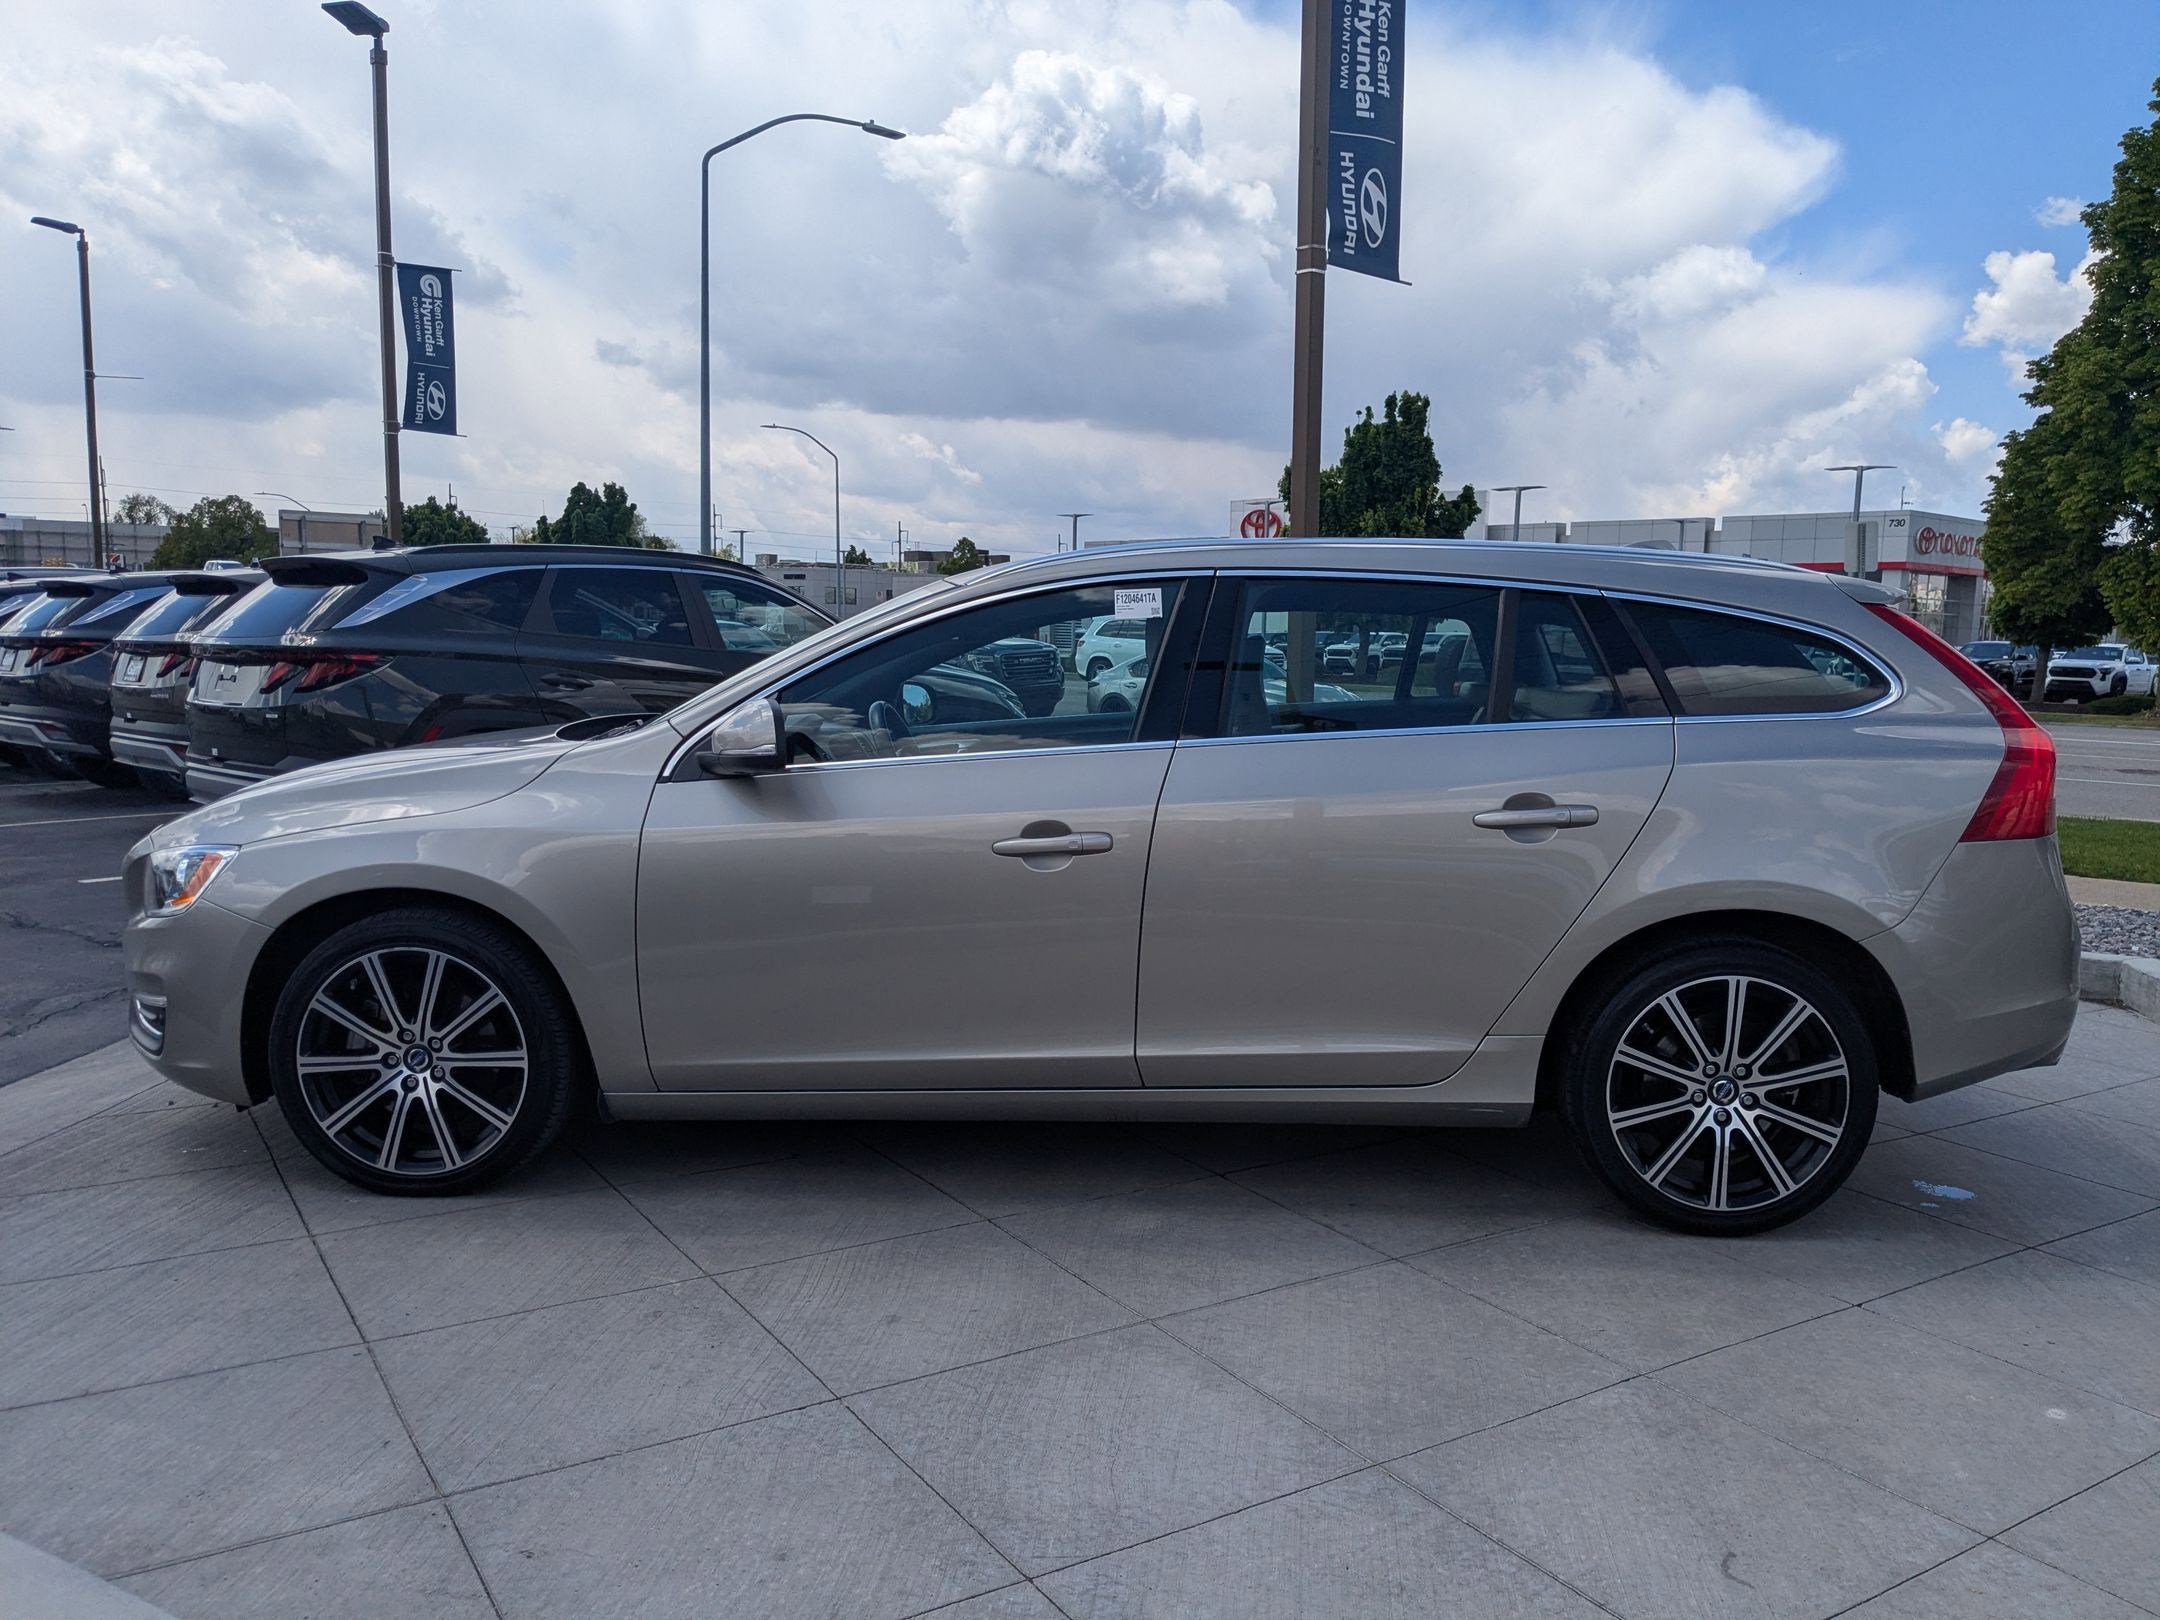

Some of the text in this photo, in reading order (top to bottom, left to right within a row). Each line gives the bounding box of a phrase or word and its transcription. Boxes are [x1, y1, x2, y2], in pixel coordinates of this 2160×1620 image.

[1340, 0, 1352, 89] OWNTOWN
[1354, 0, 1376, 119] Hyundai
[1377, 0, 1392, 98] Ken Garff
[1340, 151, 1357, 255] HYUNDAI
[412, 296, 422, 343] DOWNTOWN
[420, 297, 435, 357] Hyundai
[434, 299, 445, 347] Ken Garff
[415, 372, 425, 424] HYUNDAI
[1889, 518, 1906, 528] 730
[1116, 593, 1156, 604] F1204641TA
